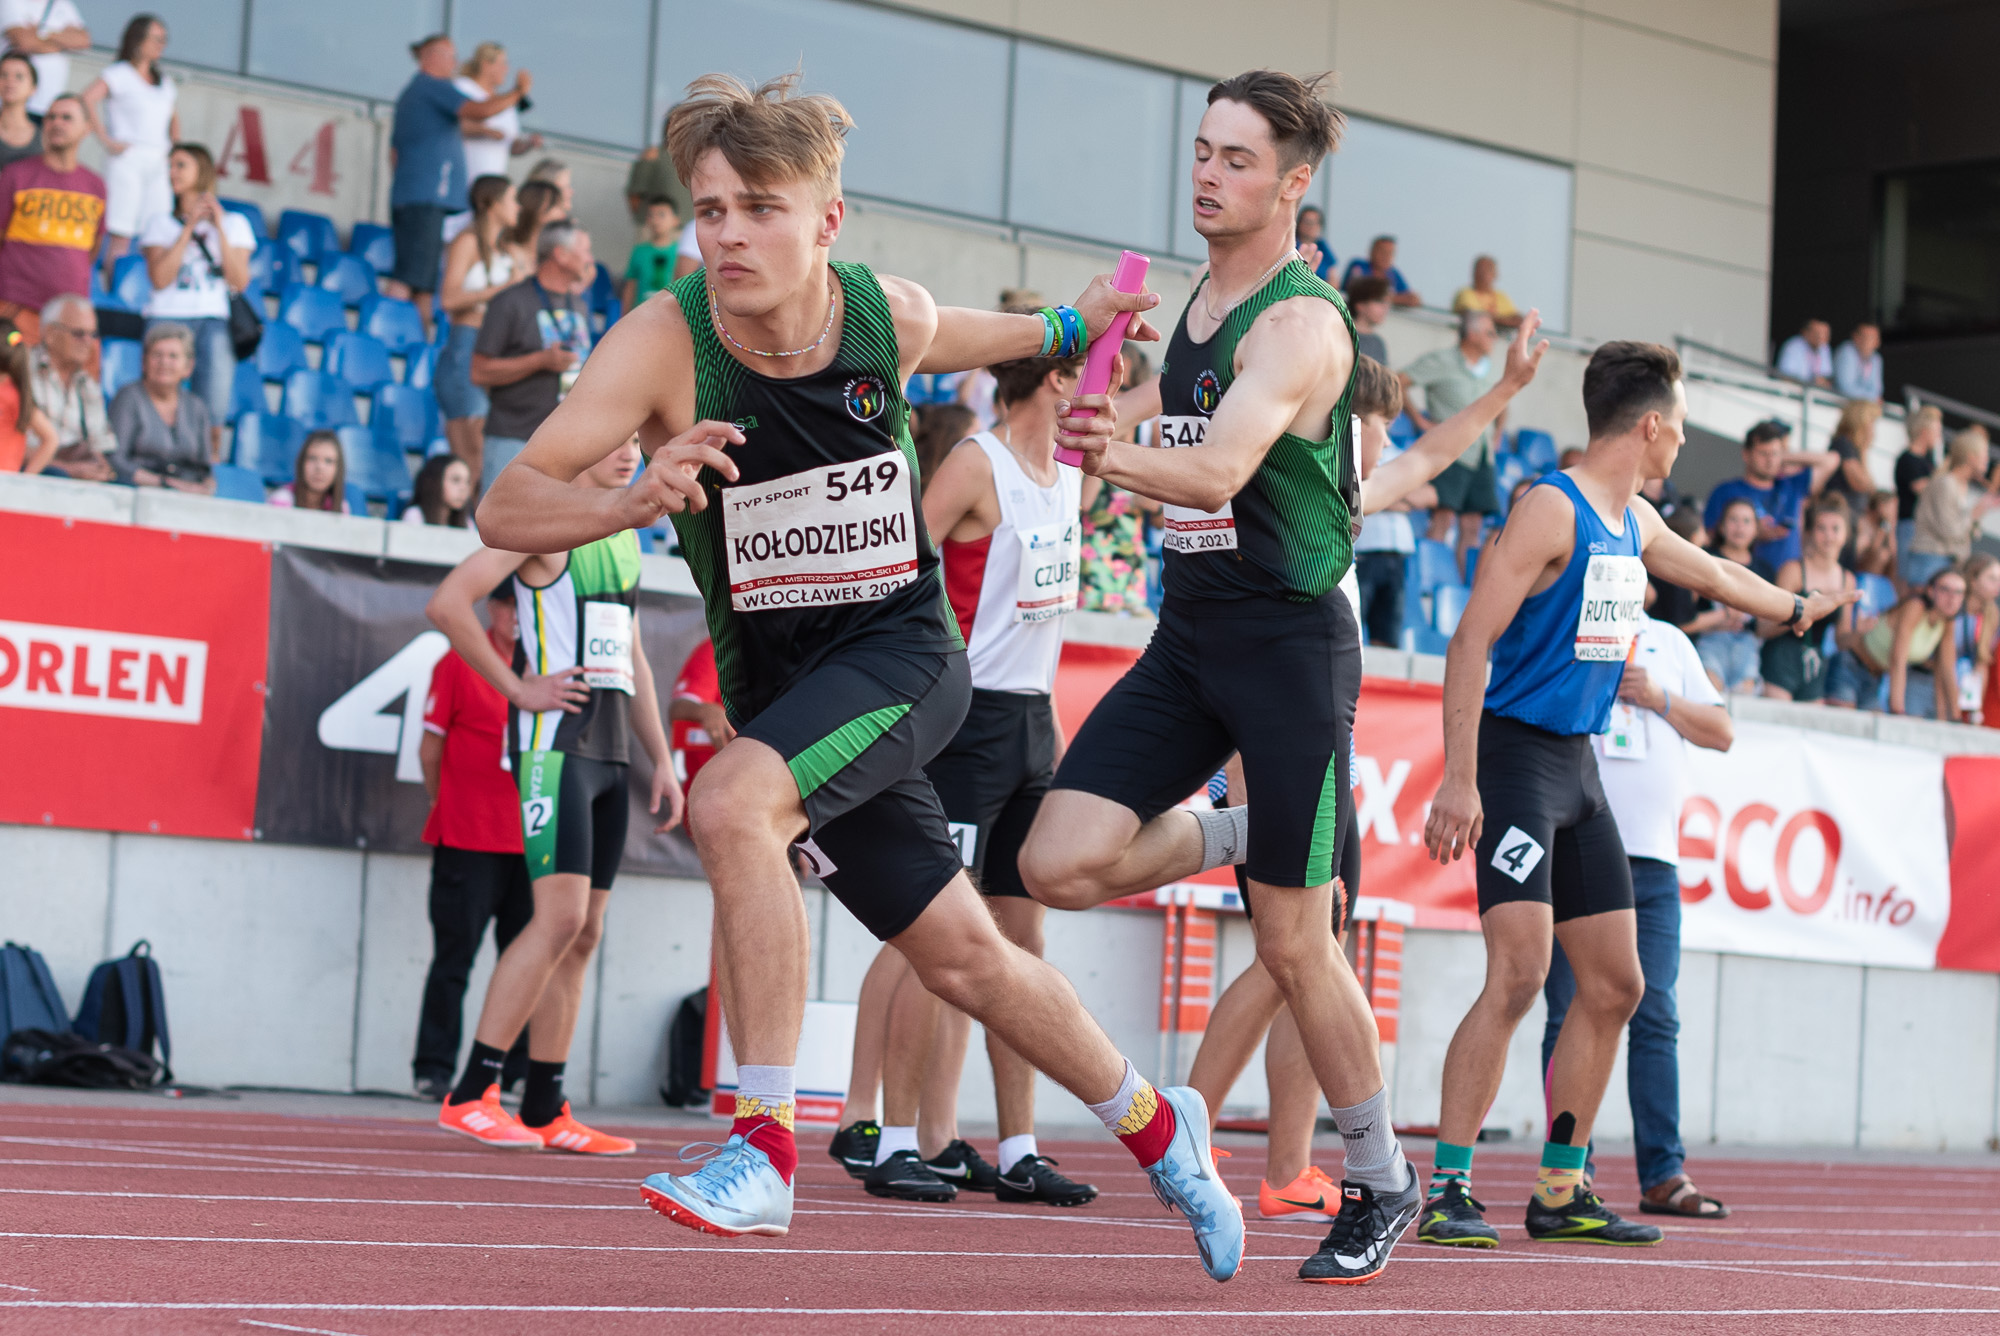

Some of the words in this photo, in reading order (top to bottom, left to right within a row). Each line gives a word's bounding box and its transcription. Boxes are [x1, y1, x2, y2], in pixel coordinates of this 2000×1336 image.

[217, 106, 271, 186] A
[289, 120, 340, 196] 4
[733, 497, 762, 511] TVP
[765, 486, 811, 504] SPORT
[826, 461, 899, 501] 549
[734, 512, 907, 564] KOŁODZIEJSKI
[1198, 533, 1230, 548] 2021
[757, 578, 783, 587] PZLA
[785, 575, 855, 584] MISTRZOSTWA
[857, 568, 892, 579] POLSKI
[893, 563, 910, 573] U18
[743, 586, 864, 608] WŁOCŁAWEK
[529, 803, 545, 831] 2
[1501, 841, 1533, 873] 4
